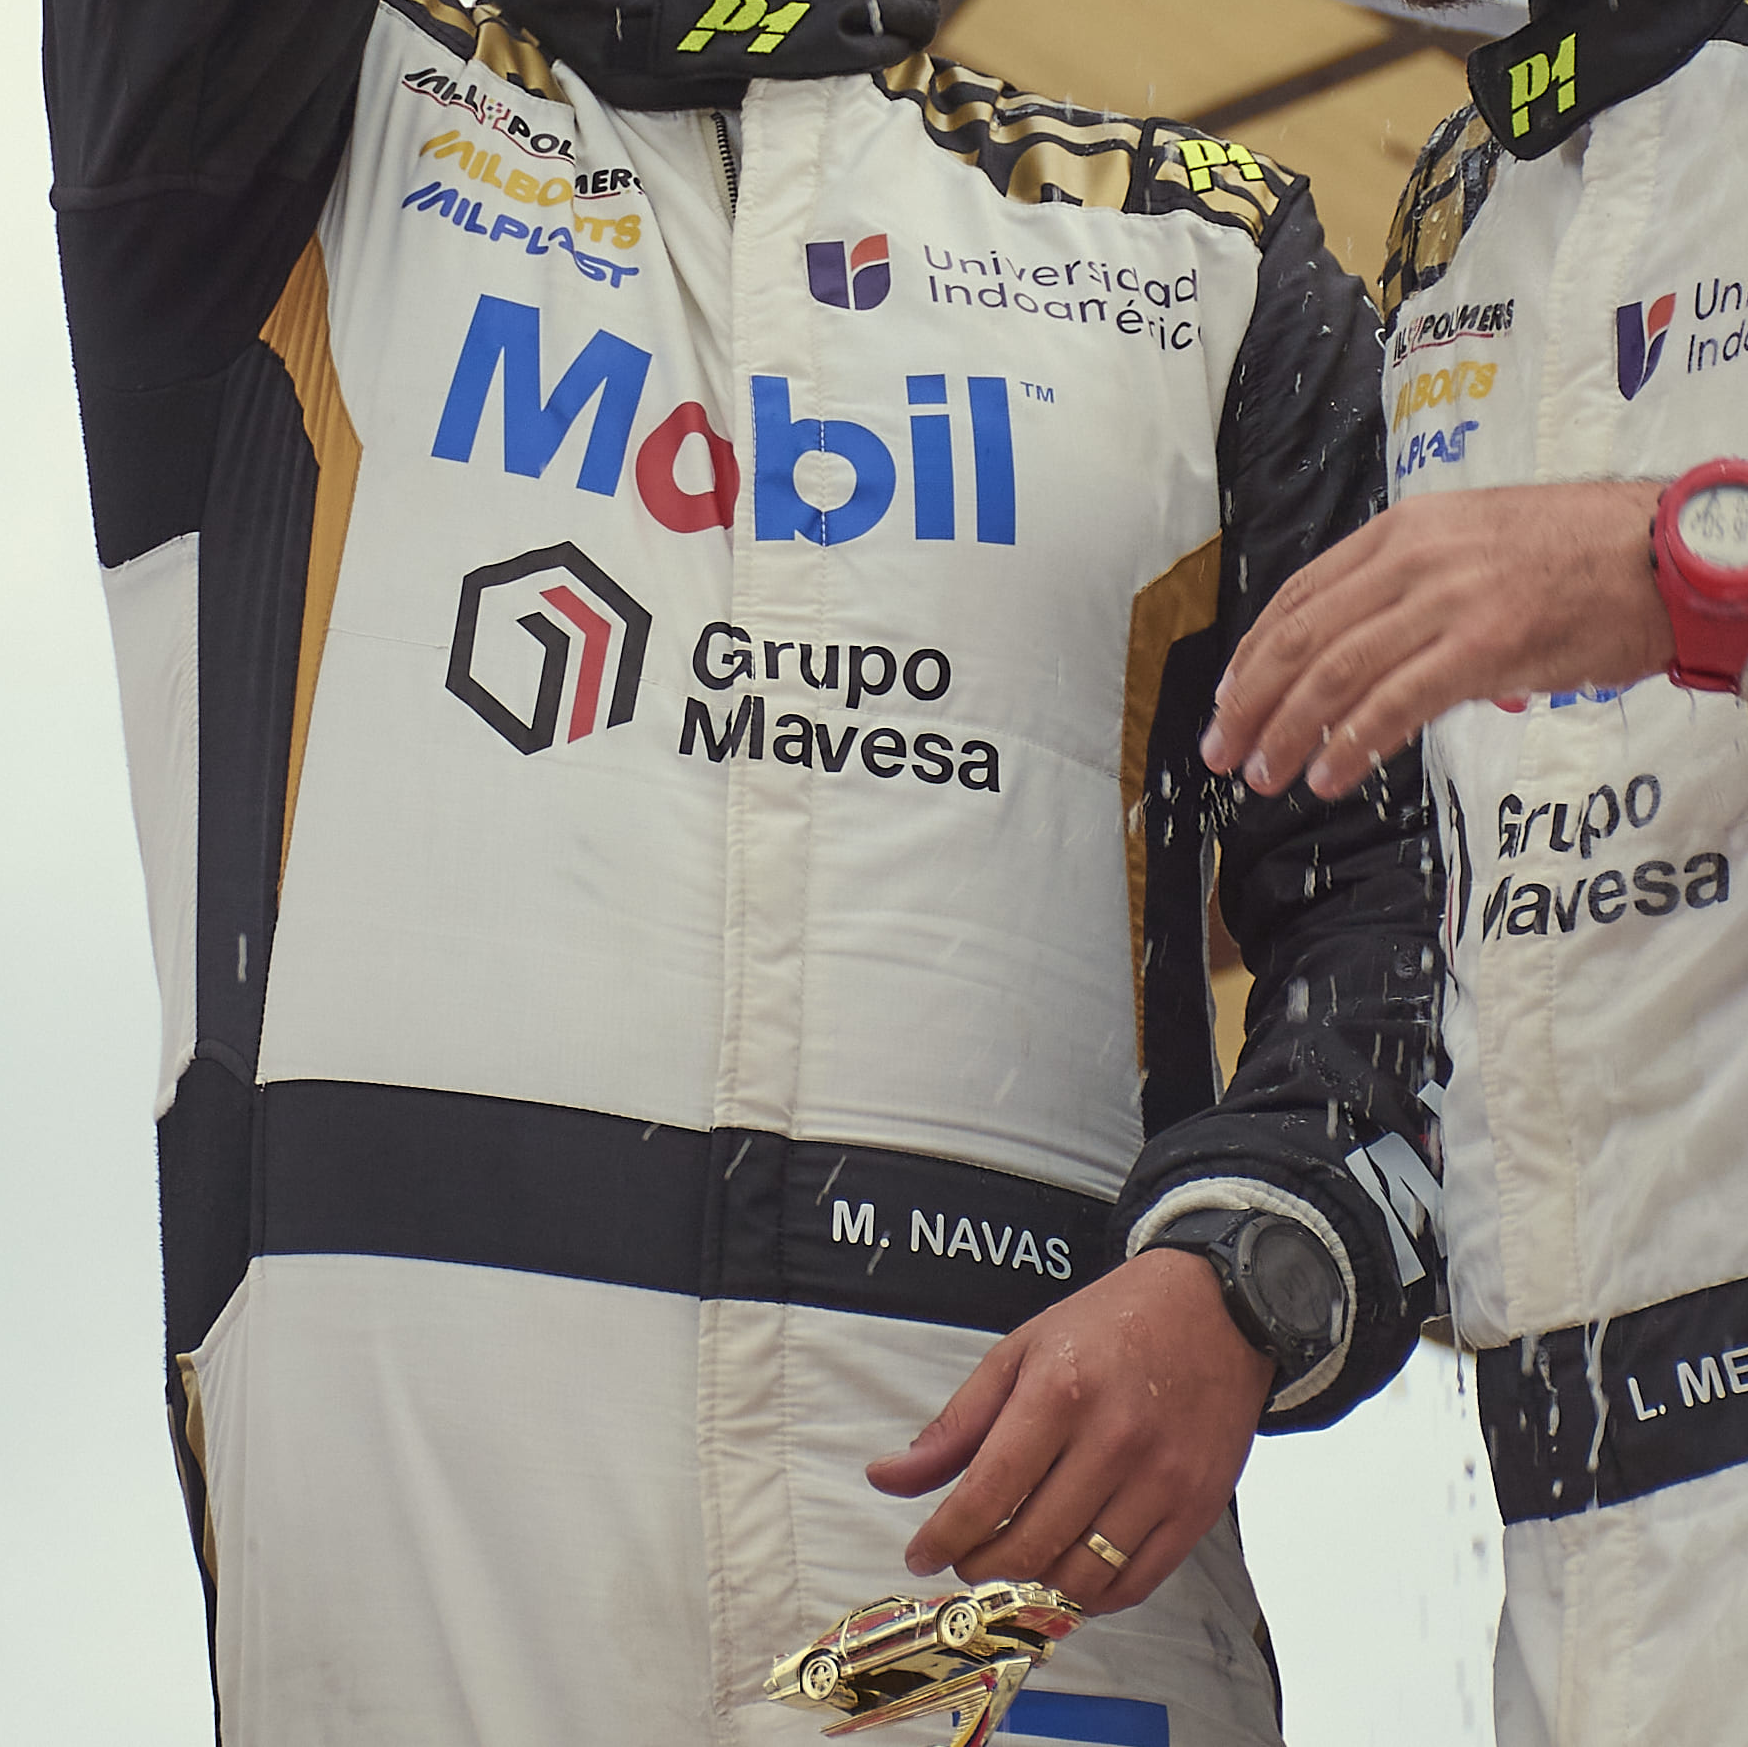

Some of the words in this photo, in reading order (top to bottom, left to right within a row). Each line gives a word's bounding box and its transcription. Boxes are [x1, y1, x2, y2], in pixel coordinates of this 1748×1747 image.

[431, 294, 1017, 546] Mobil
[692, 621, 952, 710] Grupo
[678, 694, 1002, 794] Mavesa
[1498, 773, 1662, 861] Grupo
[829, 1199, 891, 1249] M.
[909, 1209, 1073, 1282] NAVAS
[1626, 1374, 1667, 1422] L.
